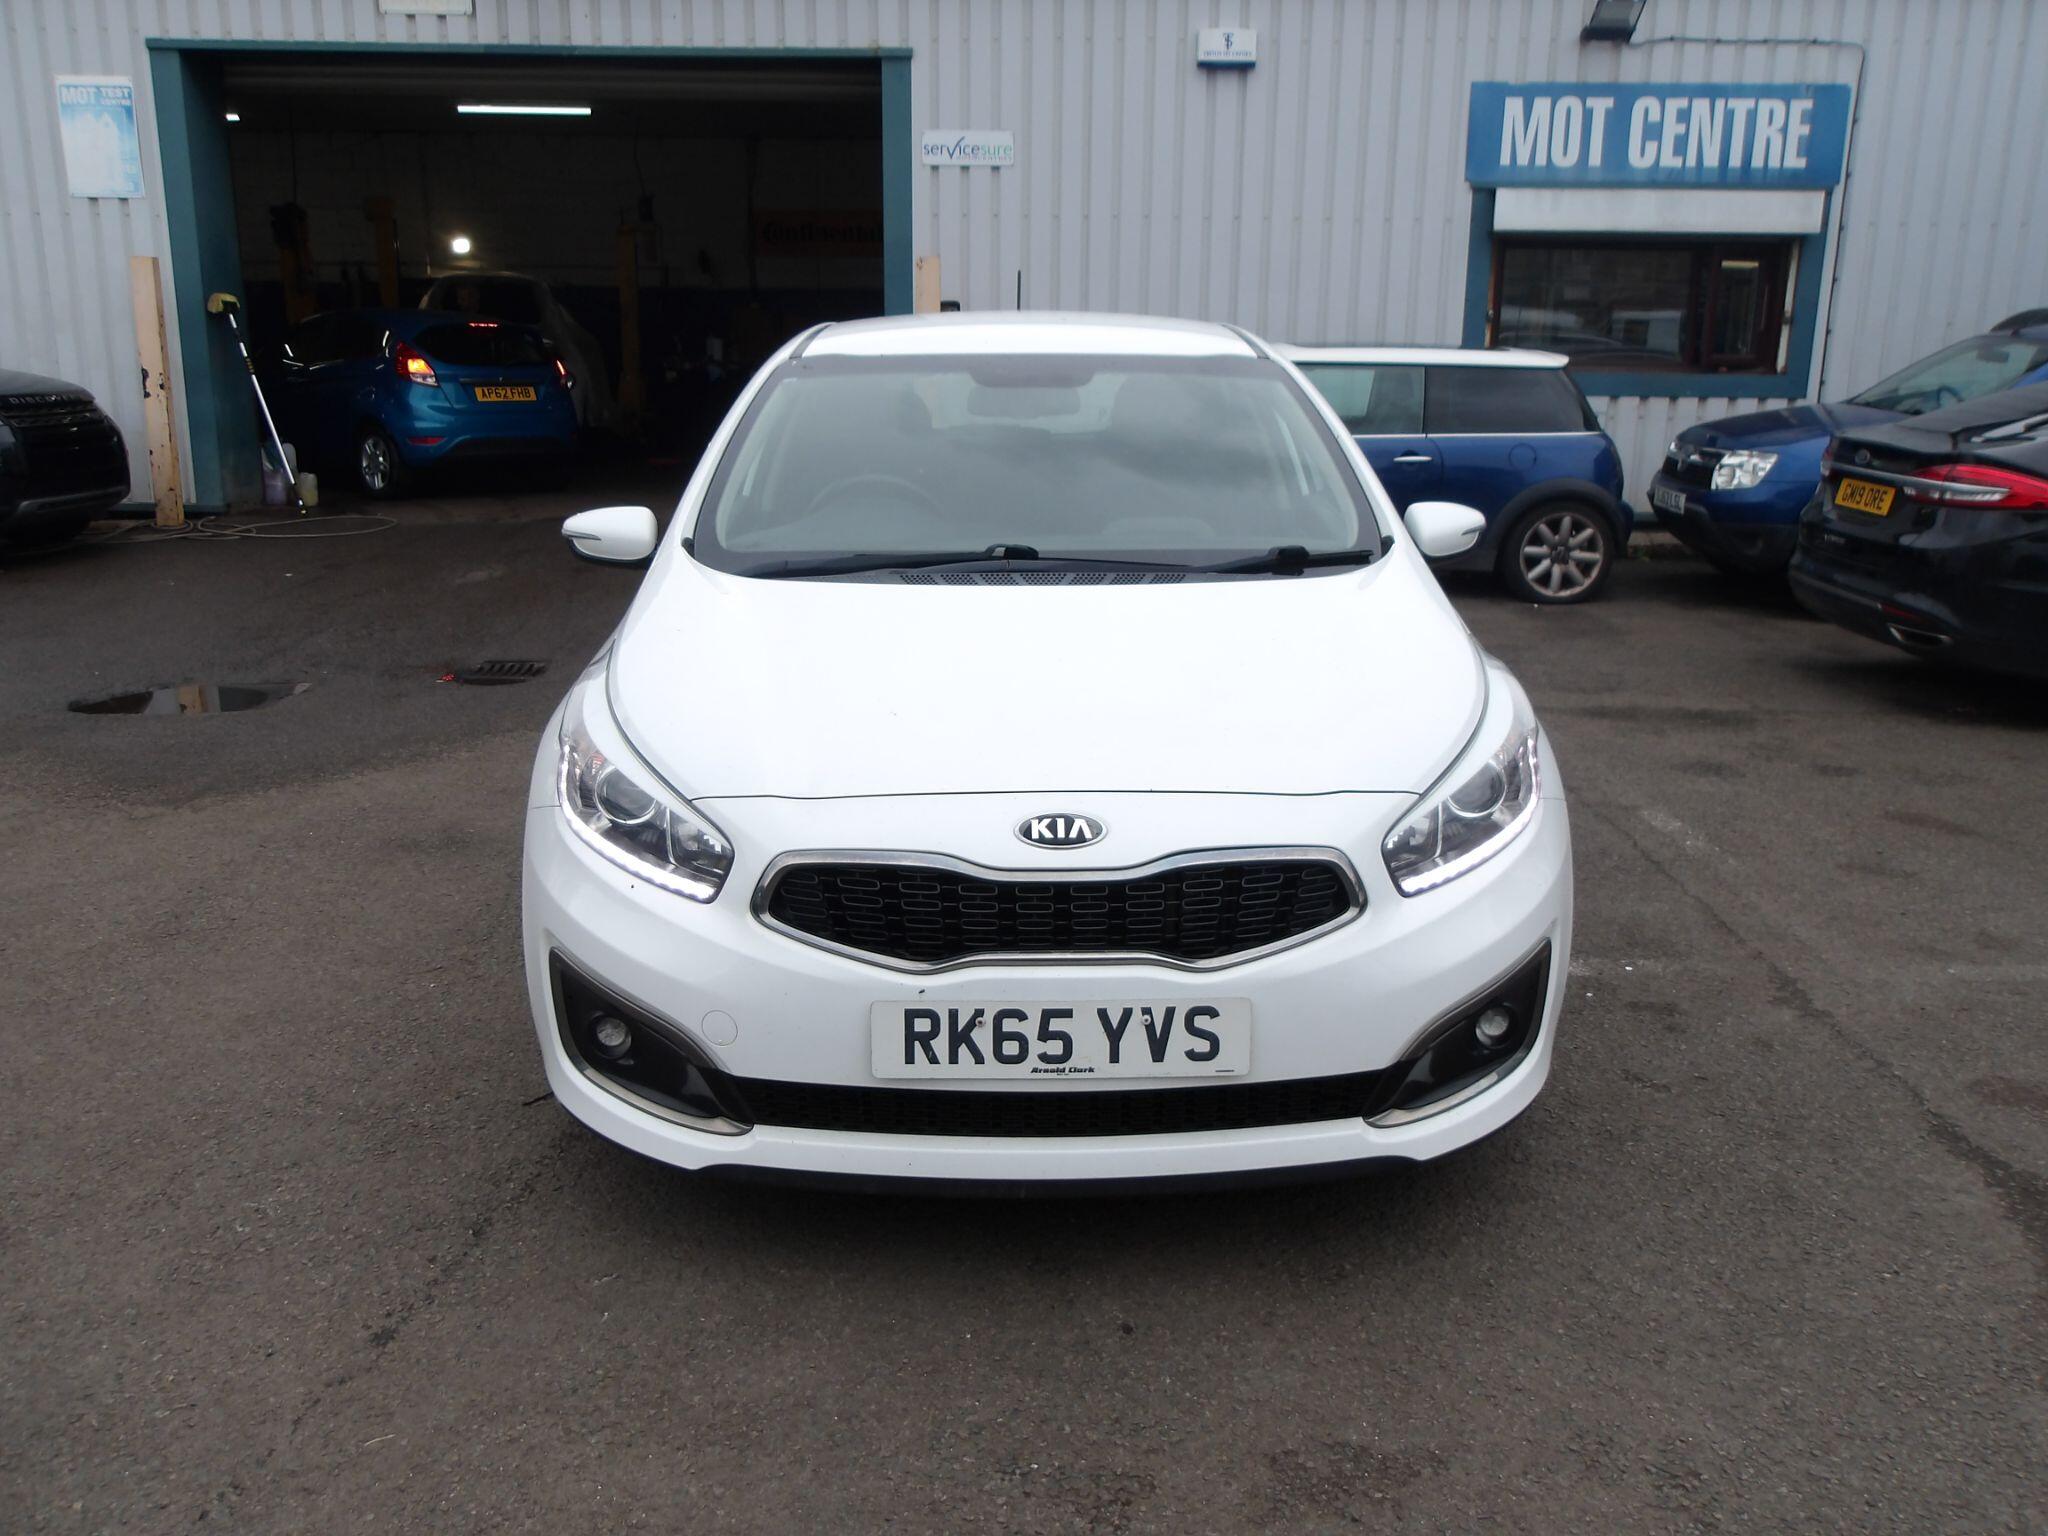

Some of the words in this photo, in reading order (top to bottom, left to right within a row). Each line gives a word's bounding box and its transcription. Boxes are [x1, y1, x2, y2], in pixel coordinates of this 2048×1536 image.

[61, 86, 97, 105] MOT
[100, 87, 130, 98] TEST
[1500, 96, 1615, 168] MOT
[1628, 95, 1814, 170] CENTRE
[923, 135, 1012, 159] servicesure
[482, 387, 509, 399] AP62
[510, 388, 531, 399] FHB
[1030, 817, 1093, 839] KIA
[904, 1008, 1074, 1065] RK65
[1096, 1005, 1221, 1064] YVS
[1030, 1066, 1066, 1074] Arnold
